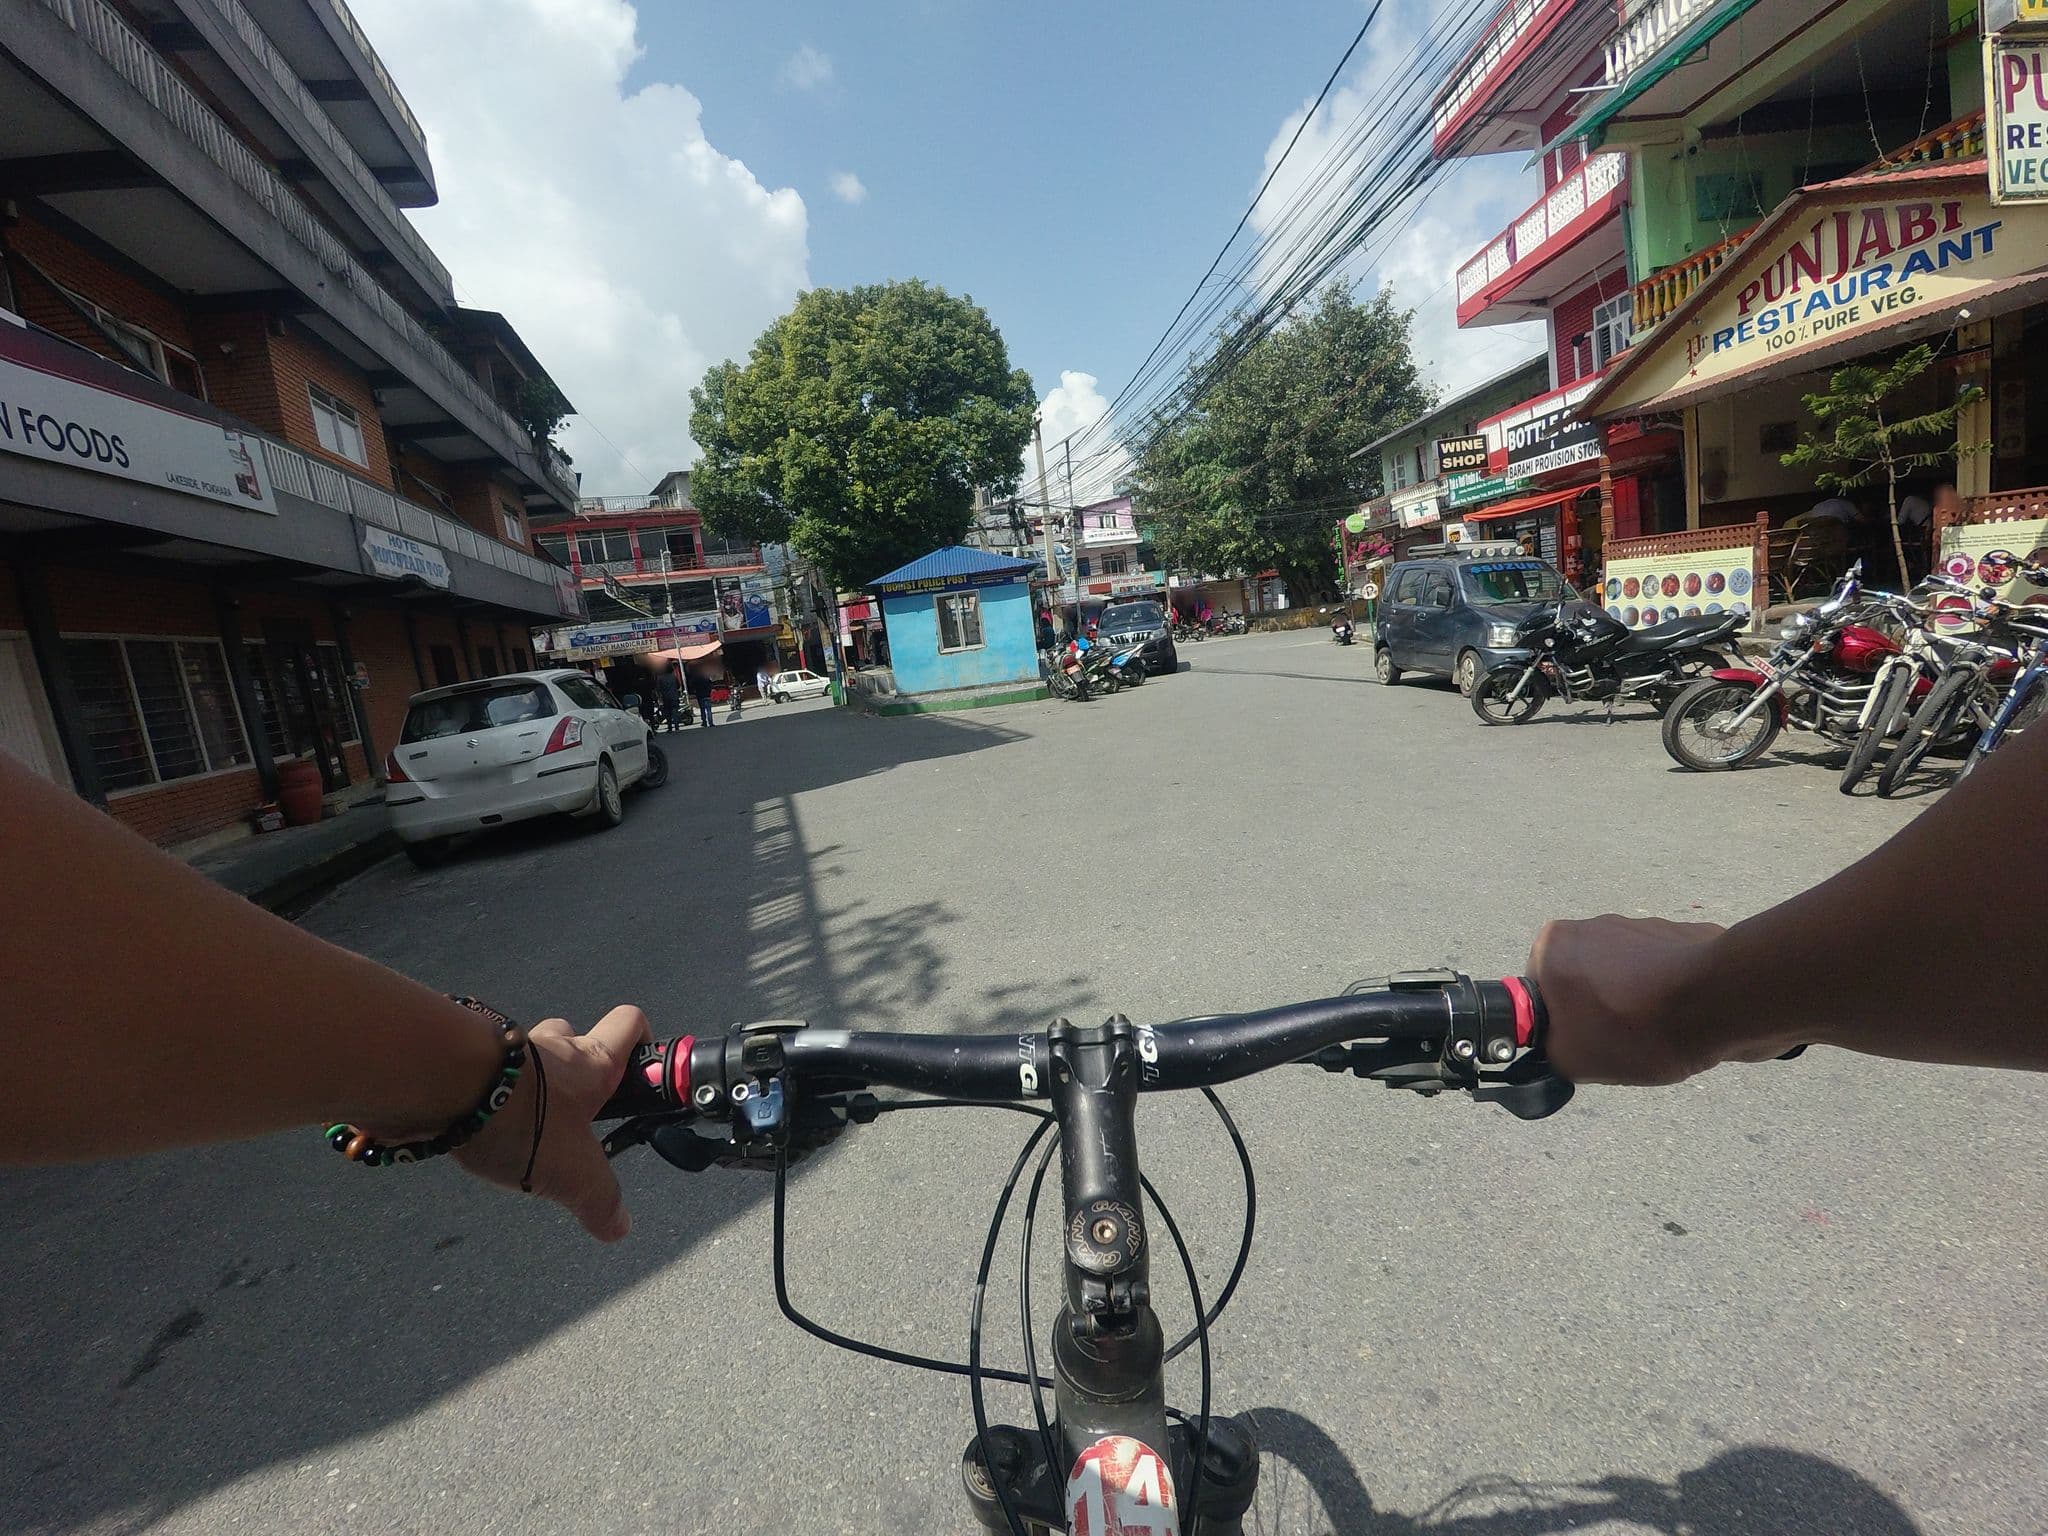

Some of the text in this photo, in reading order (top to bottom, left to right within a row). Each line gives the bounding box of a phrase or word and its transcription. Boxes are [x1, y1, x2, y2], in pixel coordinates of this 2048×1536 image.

[2007, 122, 2048, 150] RE
[1737, 201, 1964, 316] PUNJABI
[1713, 220, 2002, 353] RESTAURANT
[1765, 286, 1923, 352] 100% PURE VEG.
[17, 406, 130, 468] FOODS
[1440, 438, 1485, 454] WINE
[1442, 453, 1486, 469] SHOP
[1509, 461, 1534, 479] BARAHI
[1535, 449, 1576, 467] PROVISION
[371, 543, 426, 574] MOUNTAIN
[387, 533, 423, 555] HOTEL
[917, 578, 947, 589] POLICE
[947, 574, 968, 585] POST
[1337, 552, 1345, 582] TIME
[1480, 562, 1544, 572] SUZUKI
[582, 640, 653, 654] PANDEY HANDICRAFT
[1072, 1209, 1122, 1268] GIANT
[1091, 1199, 1142, 1257] GIANT
